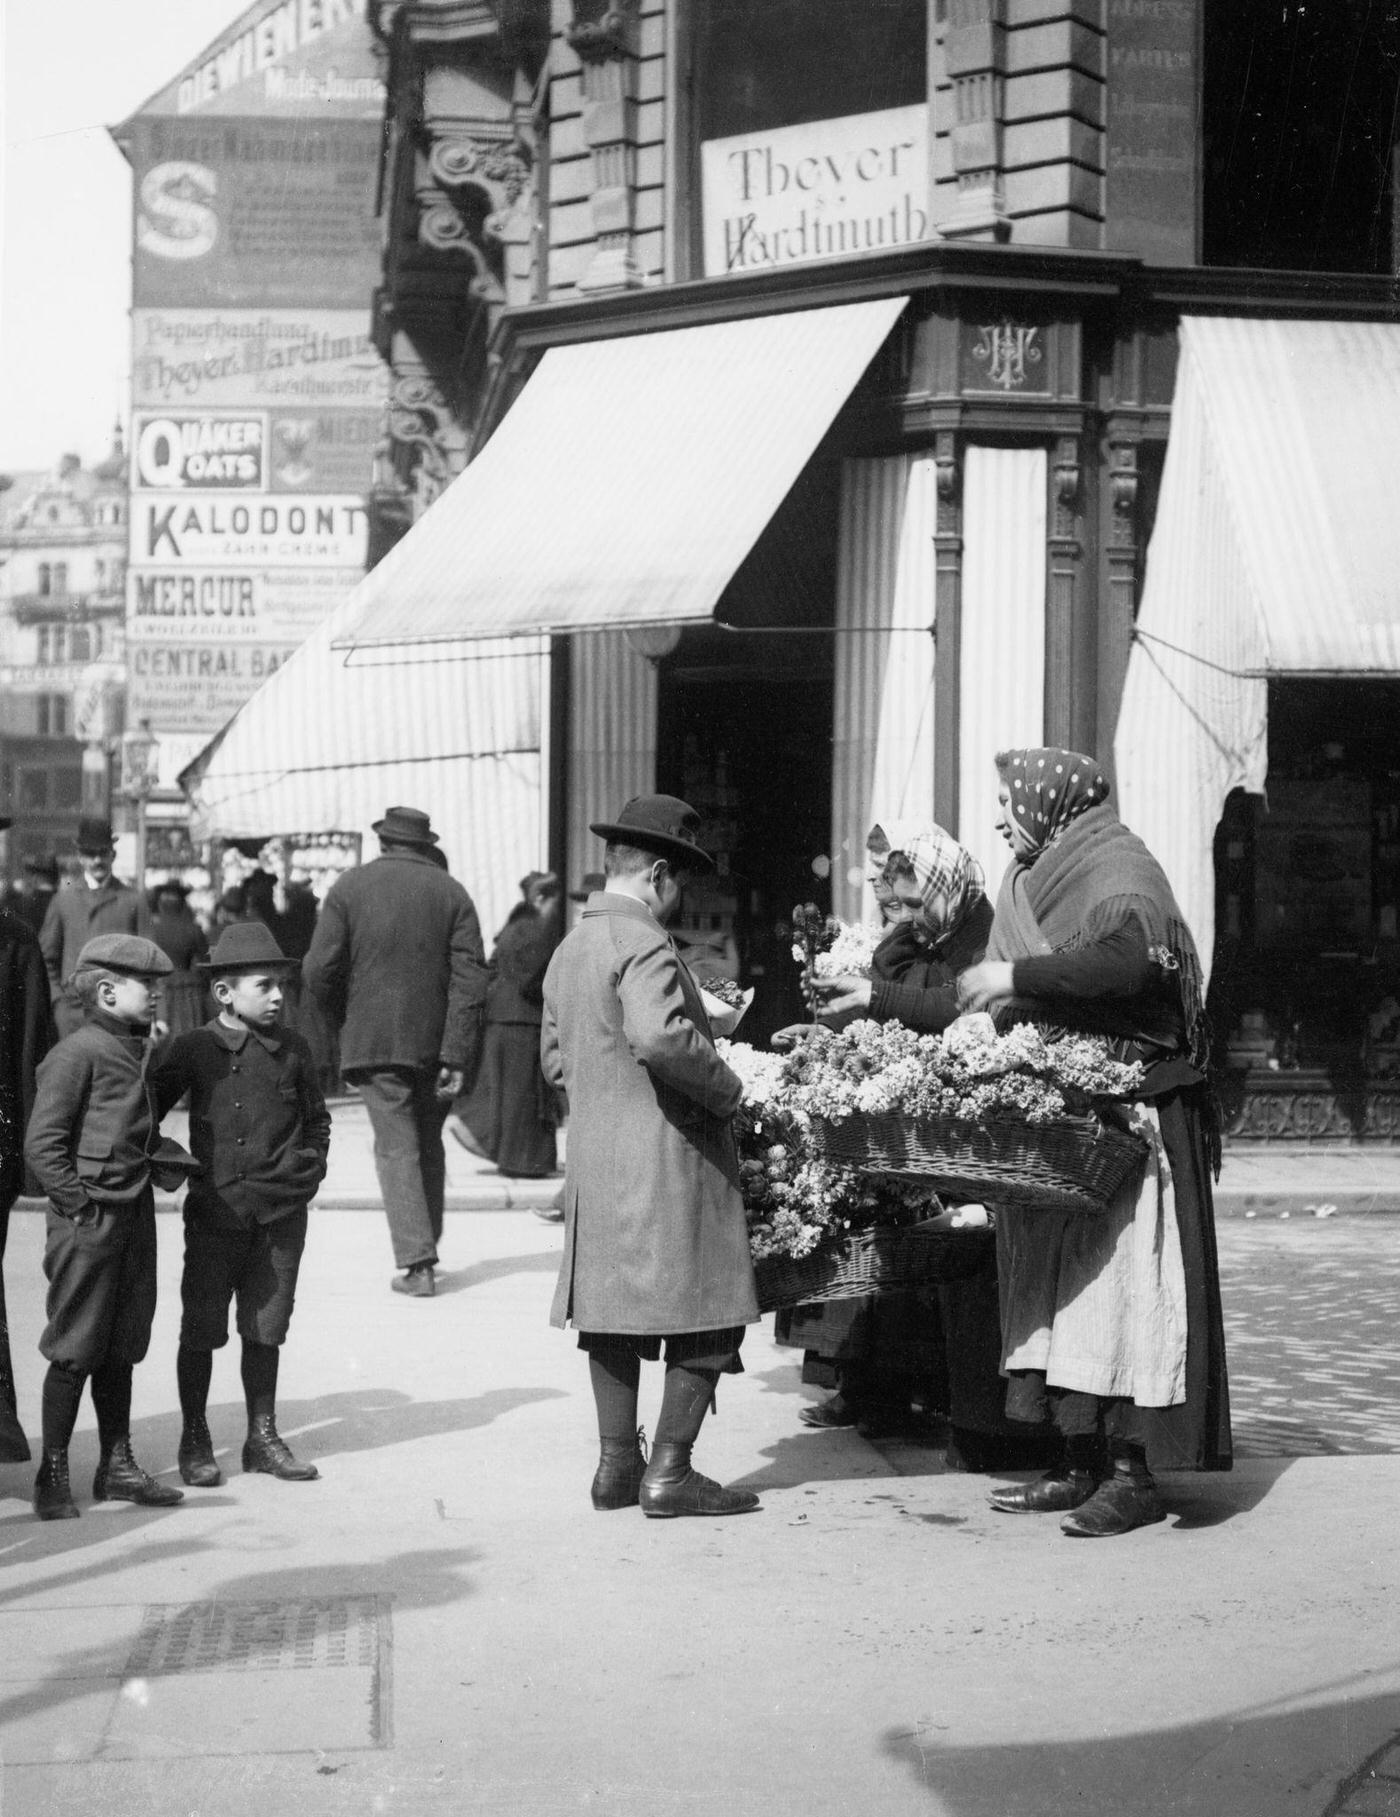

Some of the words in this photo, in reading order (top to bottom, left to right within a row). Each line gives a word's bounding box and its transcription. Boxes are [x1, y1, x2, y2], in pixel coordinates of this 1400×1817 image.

[728, 143, 914, 201] Theyer
[724, 193, 927, 271] Hardtmuth
[138, 417, 262, 487] QUAKER
[186, 454, 258, 480] OATS
[148, 505, 365, 557] KALODONT
[136, 574, 256, 617] MERCUR
[135, 649, 243, 677] CENTRAL
